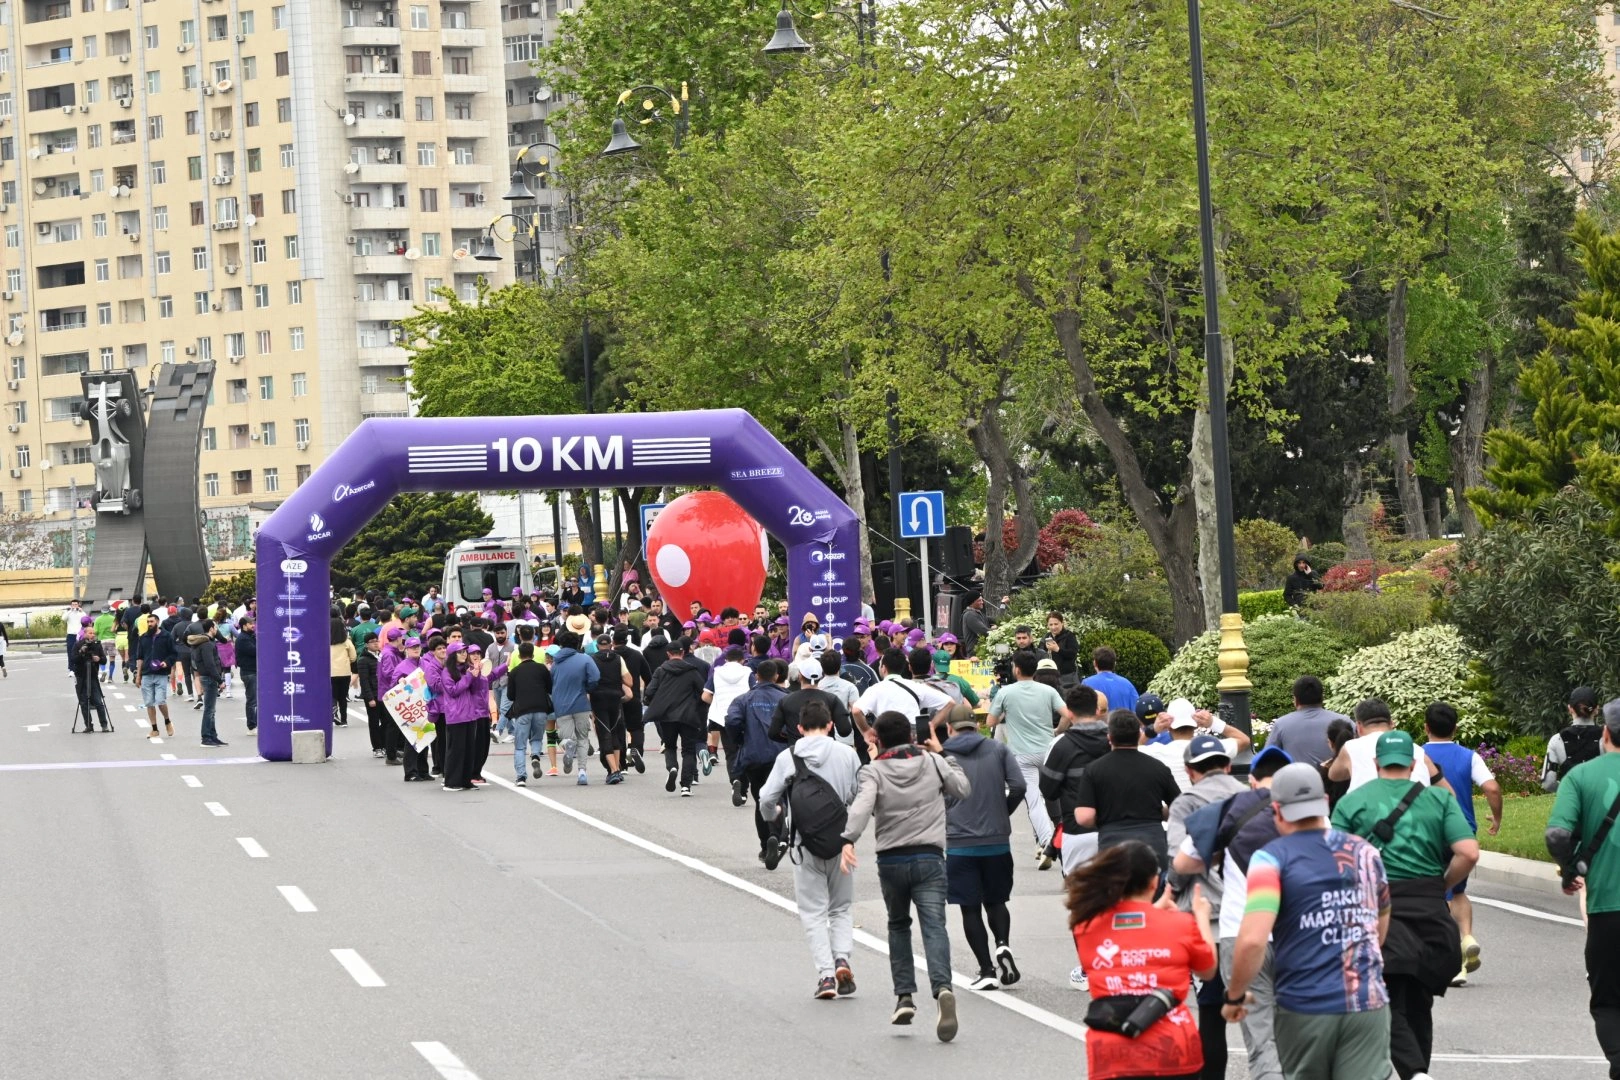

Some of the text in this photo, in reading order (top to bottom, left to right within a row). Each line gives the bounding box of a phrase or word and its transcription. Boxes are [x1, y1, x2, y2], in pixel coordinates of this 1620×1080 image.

[492, 435, 624, 473] 10 KM
[731, 467, 783, 479] SEA BREEZE
[348, 480, 375, 496] Azercell
[307, 531, 331, 541] SOCAR
[460, 551, 516, 562] AMBULANCE
[285, 562, 303, 570] AZE
[823, 596, 847, 604] GROUP
[408, 703, 424, 719] NOT
[416, 700, 428, 712] DO
[394, 702, 416, 723] STOP
[1321, 889, 1362, 908] BAKU
[1321, 926, 1362, 945] CLUB
[1121, 948, 1171, 960] DOCTOR
[1121, 957, 1146, 967] RUN
